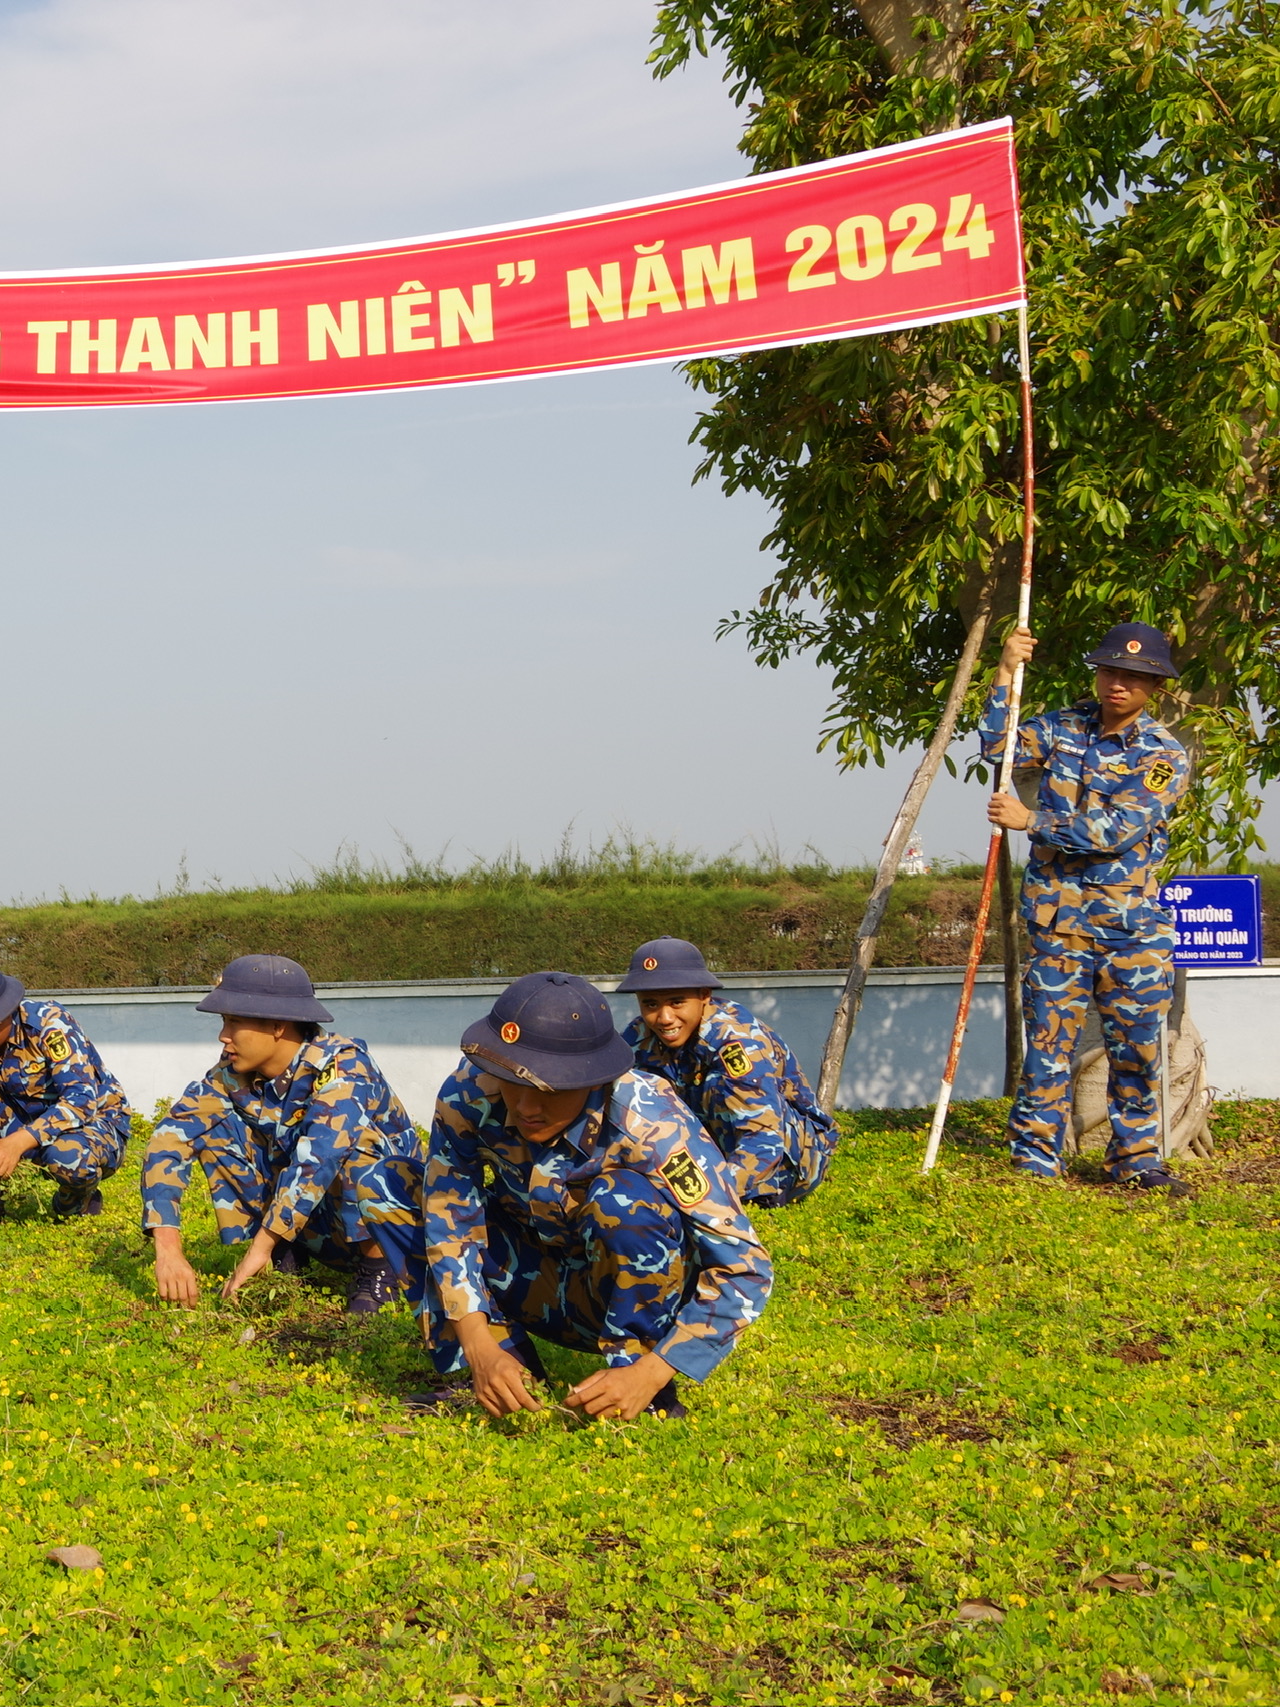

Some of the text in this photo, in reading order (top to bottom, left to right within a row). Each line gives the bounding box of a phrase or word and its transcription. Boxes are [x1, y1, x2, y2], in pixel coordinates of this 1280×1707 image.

[27, 308, 280, 374] THANH
[306, 259, 537, 363] NIÊN”
[566, 239, 760, 330] NĂM
[784, 192, 996, 294] 2024
[1164, 884, 1193, 904] SỘP
[1180, 904, 1233, 923] TRƯỞNG
[1183, 931, 1192, 945] 2
[1193, 927, 1214, 945] HẢI
[1215, 928, 1249, 947] QUÂN
